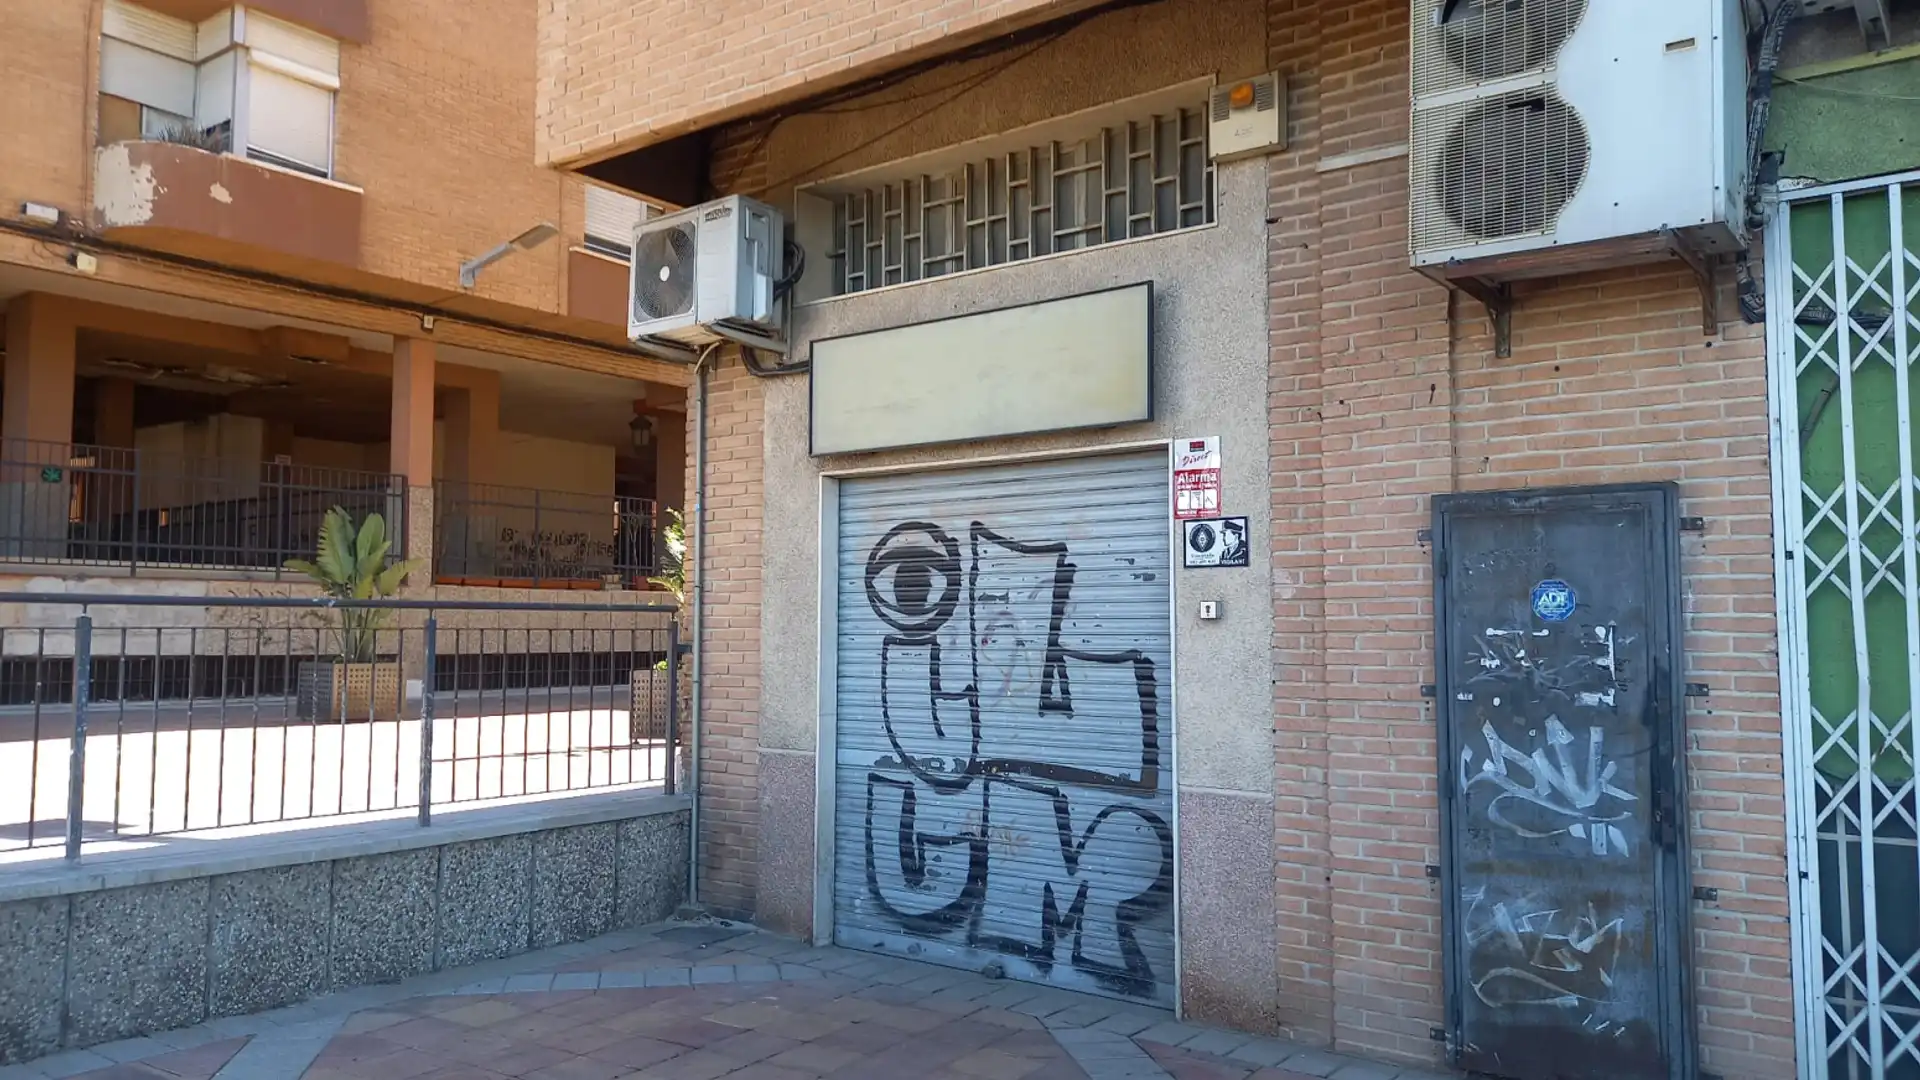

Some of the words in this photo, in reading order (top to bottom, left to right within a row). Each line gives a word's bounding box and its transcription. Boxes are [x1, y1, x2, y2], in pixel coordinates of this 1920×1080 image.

[1182, 450, 1212, 467] Direct
[1177, 471, 1217, 483] Alarma
[1538, 591, 1568, 606] ADT
